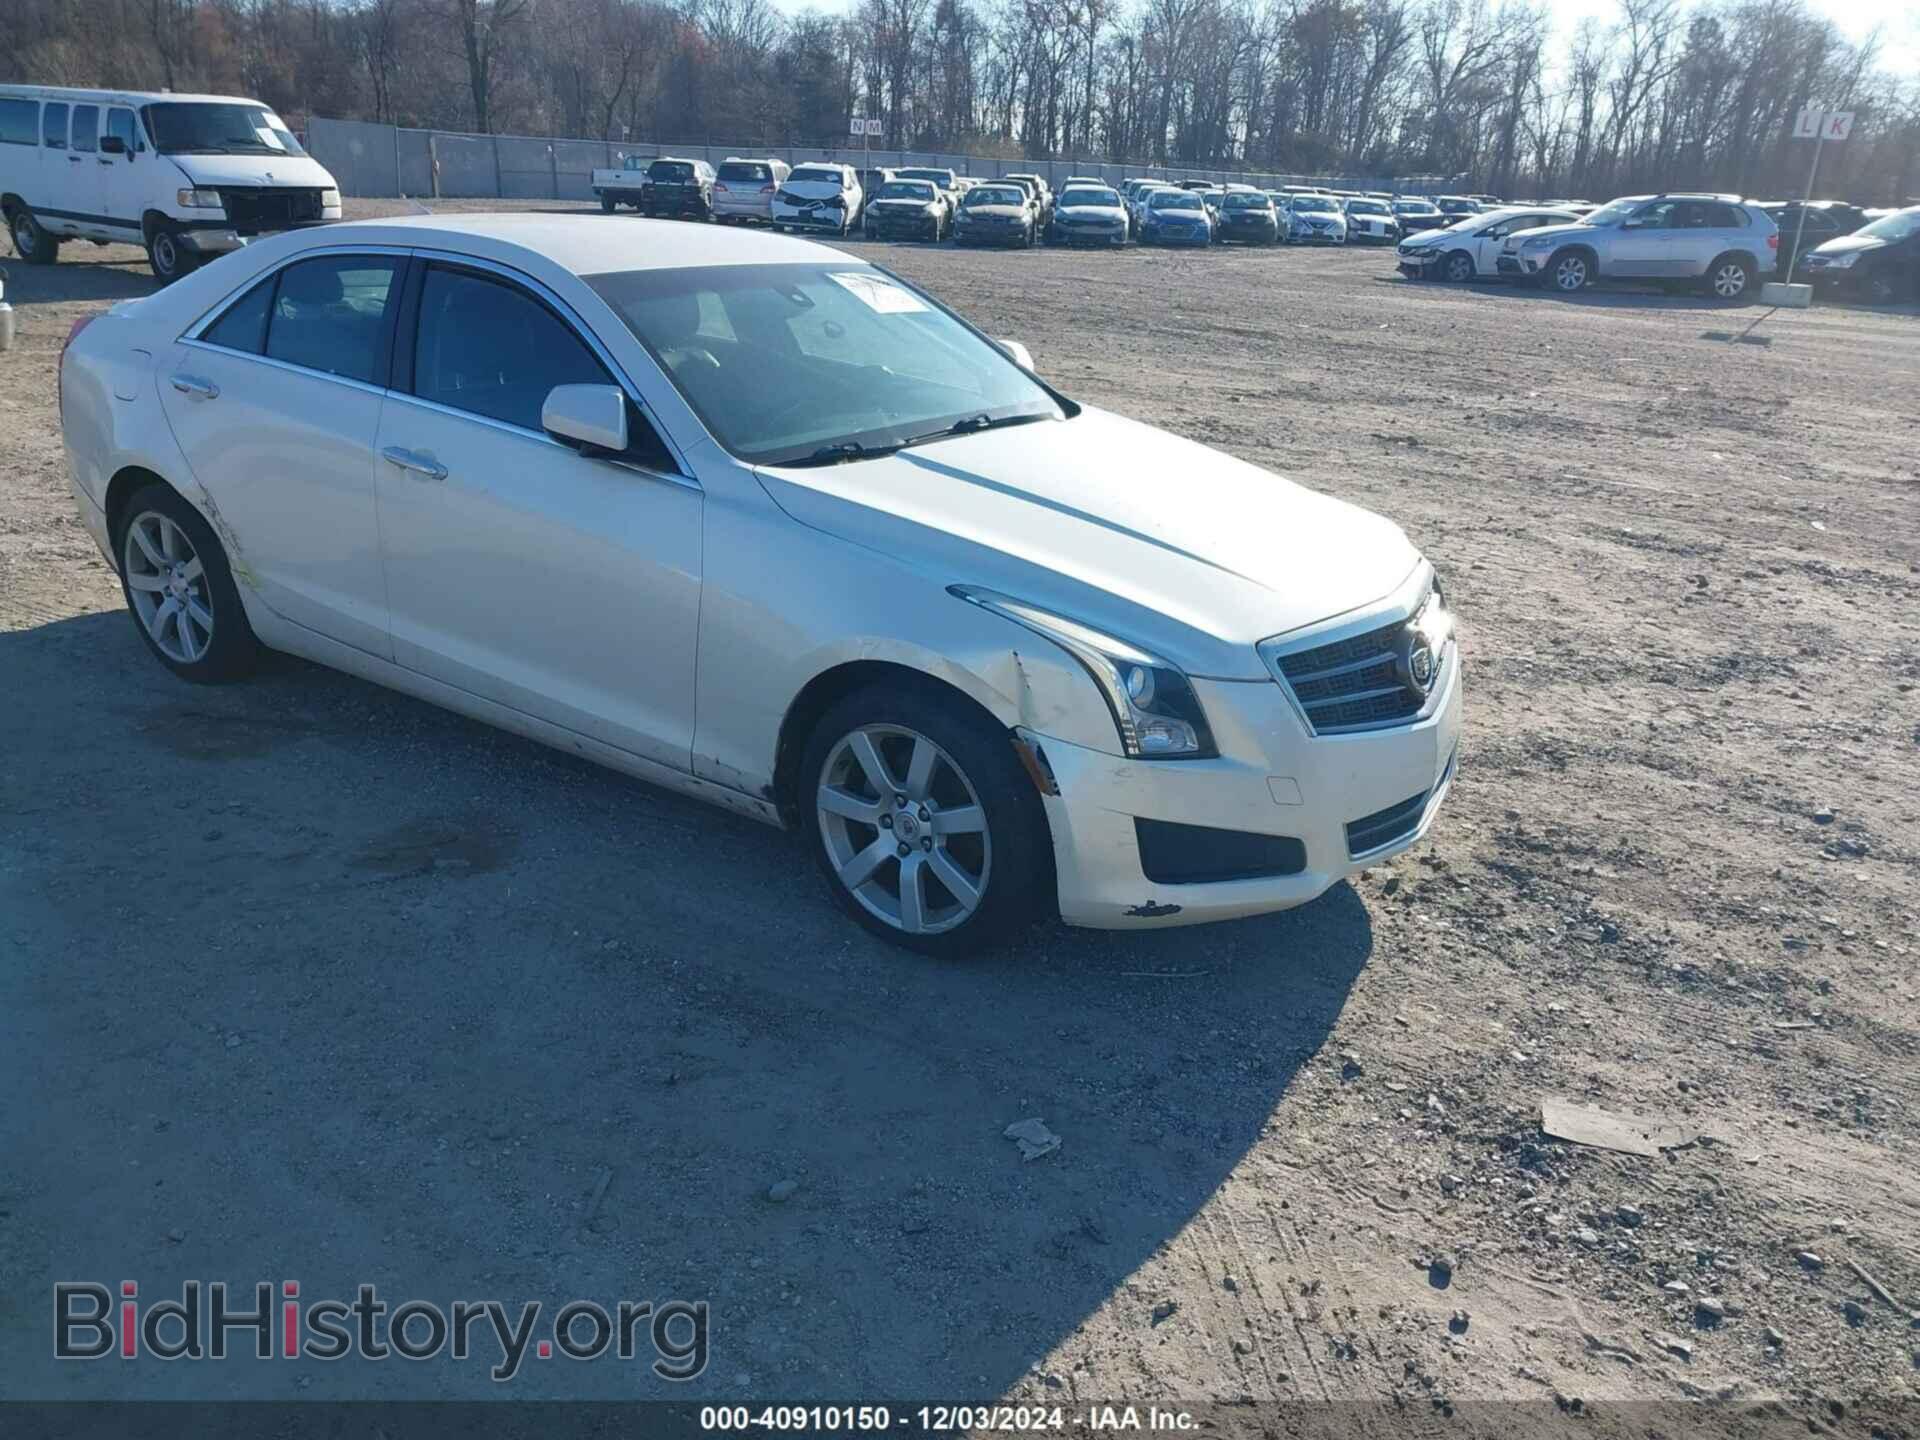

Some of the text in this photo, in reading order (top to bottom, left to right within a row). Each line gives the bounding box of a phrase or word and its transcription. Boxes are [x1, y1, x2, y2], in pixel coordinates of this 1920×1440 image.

[853, 121, 863, 132] N
[1801, 114, 1813, 133] L
[1831, 117, 1848, 135] K
